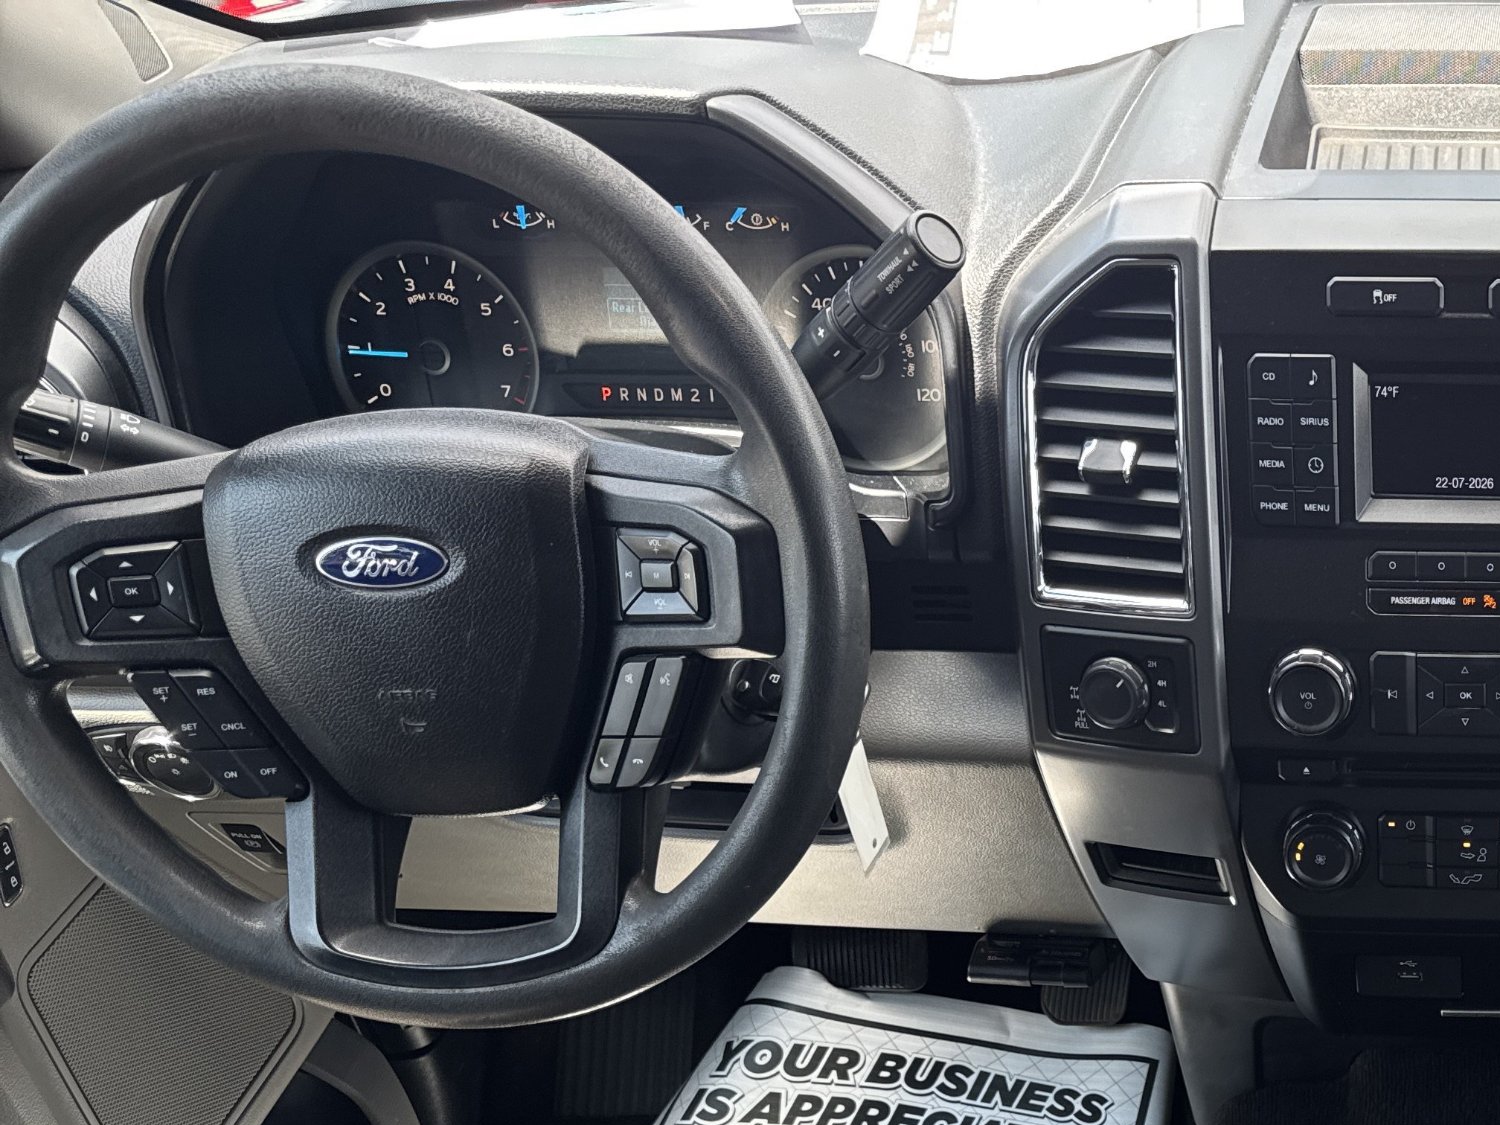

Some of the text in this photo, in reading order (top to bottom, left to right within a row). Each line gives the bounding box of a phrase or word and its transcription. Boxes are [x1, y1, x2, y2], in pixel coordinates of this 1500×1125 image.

[493, 219, 500, 228] L
[547, 220, 555, 230] H
[703, 221, 710, 230] F
[781, 223, 790, 232] H
[404, 278, 416, 292] 3
[444, 278, 455, 292] 4
[886, 274, 904, 294] SPORT
[407, 292, 426, 305] RPM
[437, 292, 459, 306] 1000
[1384, 294, 1398, 302] OFF
[376, 302, 386, 316] 2
[480, 303, 492, 316] 5
[612, 301, 634, 312] Rear
[502, 344, 514, 356] 6
[1262, 372, 1276, 380] CD
[380, 384, 392, 397] 0
[500, 385, 512, 398] 7
[602, 386, 612, 400] P
[620, 388, 630, 400] R
[637, 388, 646, 400] N
[654, 388, 664, 401] D
[671, 388, 682, 401] M
[690, 388, 700, 401] 2
[917, 388, 942, 402] 120
[1374, 386, 1400, 398] 74°F
[1257, 416, 1284, 426] RADIO
[1300, 417, 1330, 426] SIRIUS
[1258, 460, 1286, 468] MEDIA
[1435, 477, 1494, 490] 22-07-2026
[1260, 502, 1288, 510] PHONE
[1304, 503, 1330, 512] MENU
[342, 543, 420, 578] Ford
[124, 587, 138, 596] OK
[1390, 596, 1476, 606] PASSENGER AIRBAG OFF
[152, 687, 170, 695] SET
[196, 688, 216, 696] RES
[1300, 692, 1316, 700] VOL
[1459, 692, 1472, 700] OK
[181, 723, 198, 732] SET
[221, 722, 246, 731] CNCL
[260, 768, 277, 776] OFF
[714, 1038, 1114, 1125] YOUR BUSINESS
[681, 1087, 738, 1124] IS
